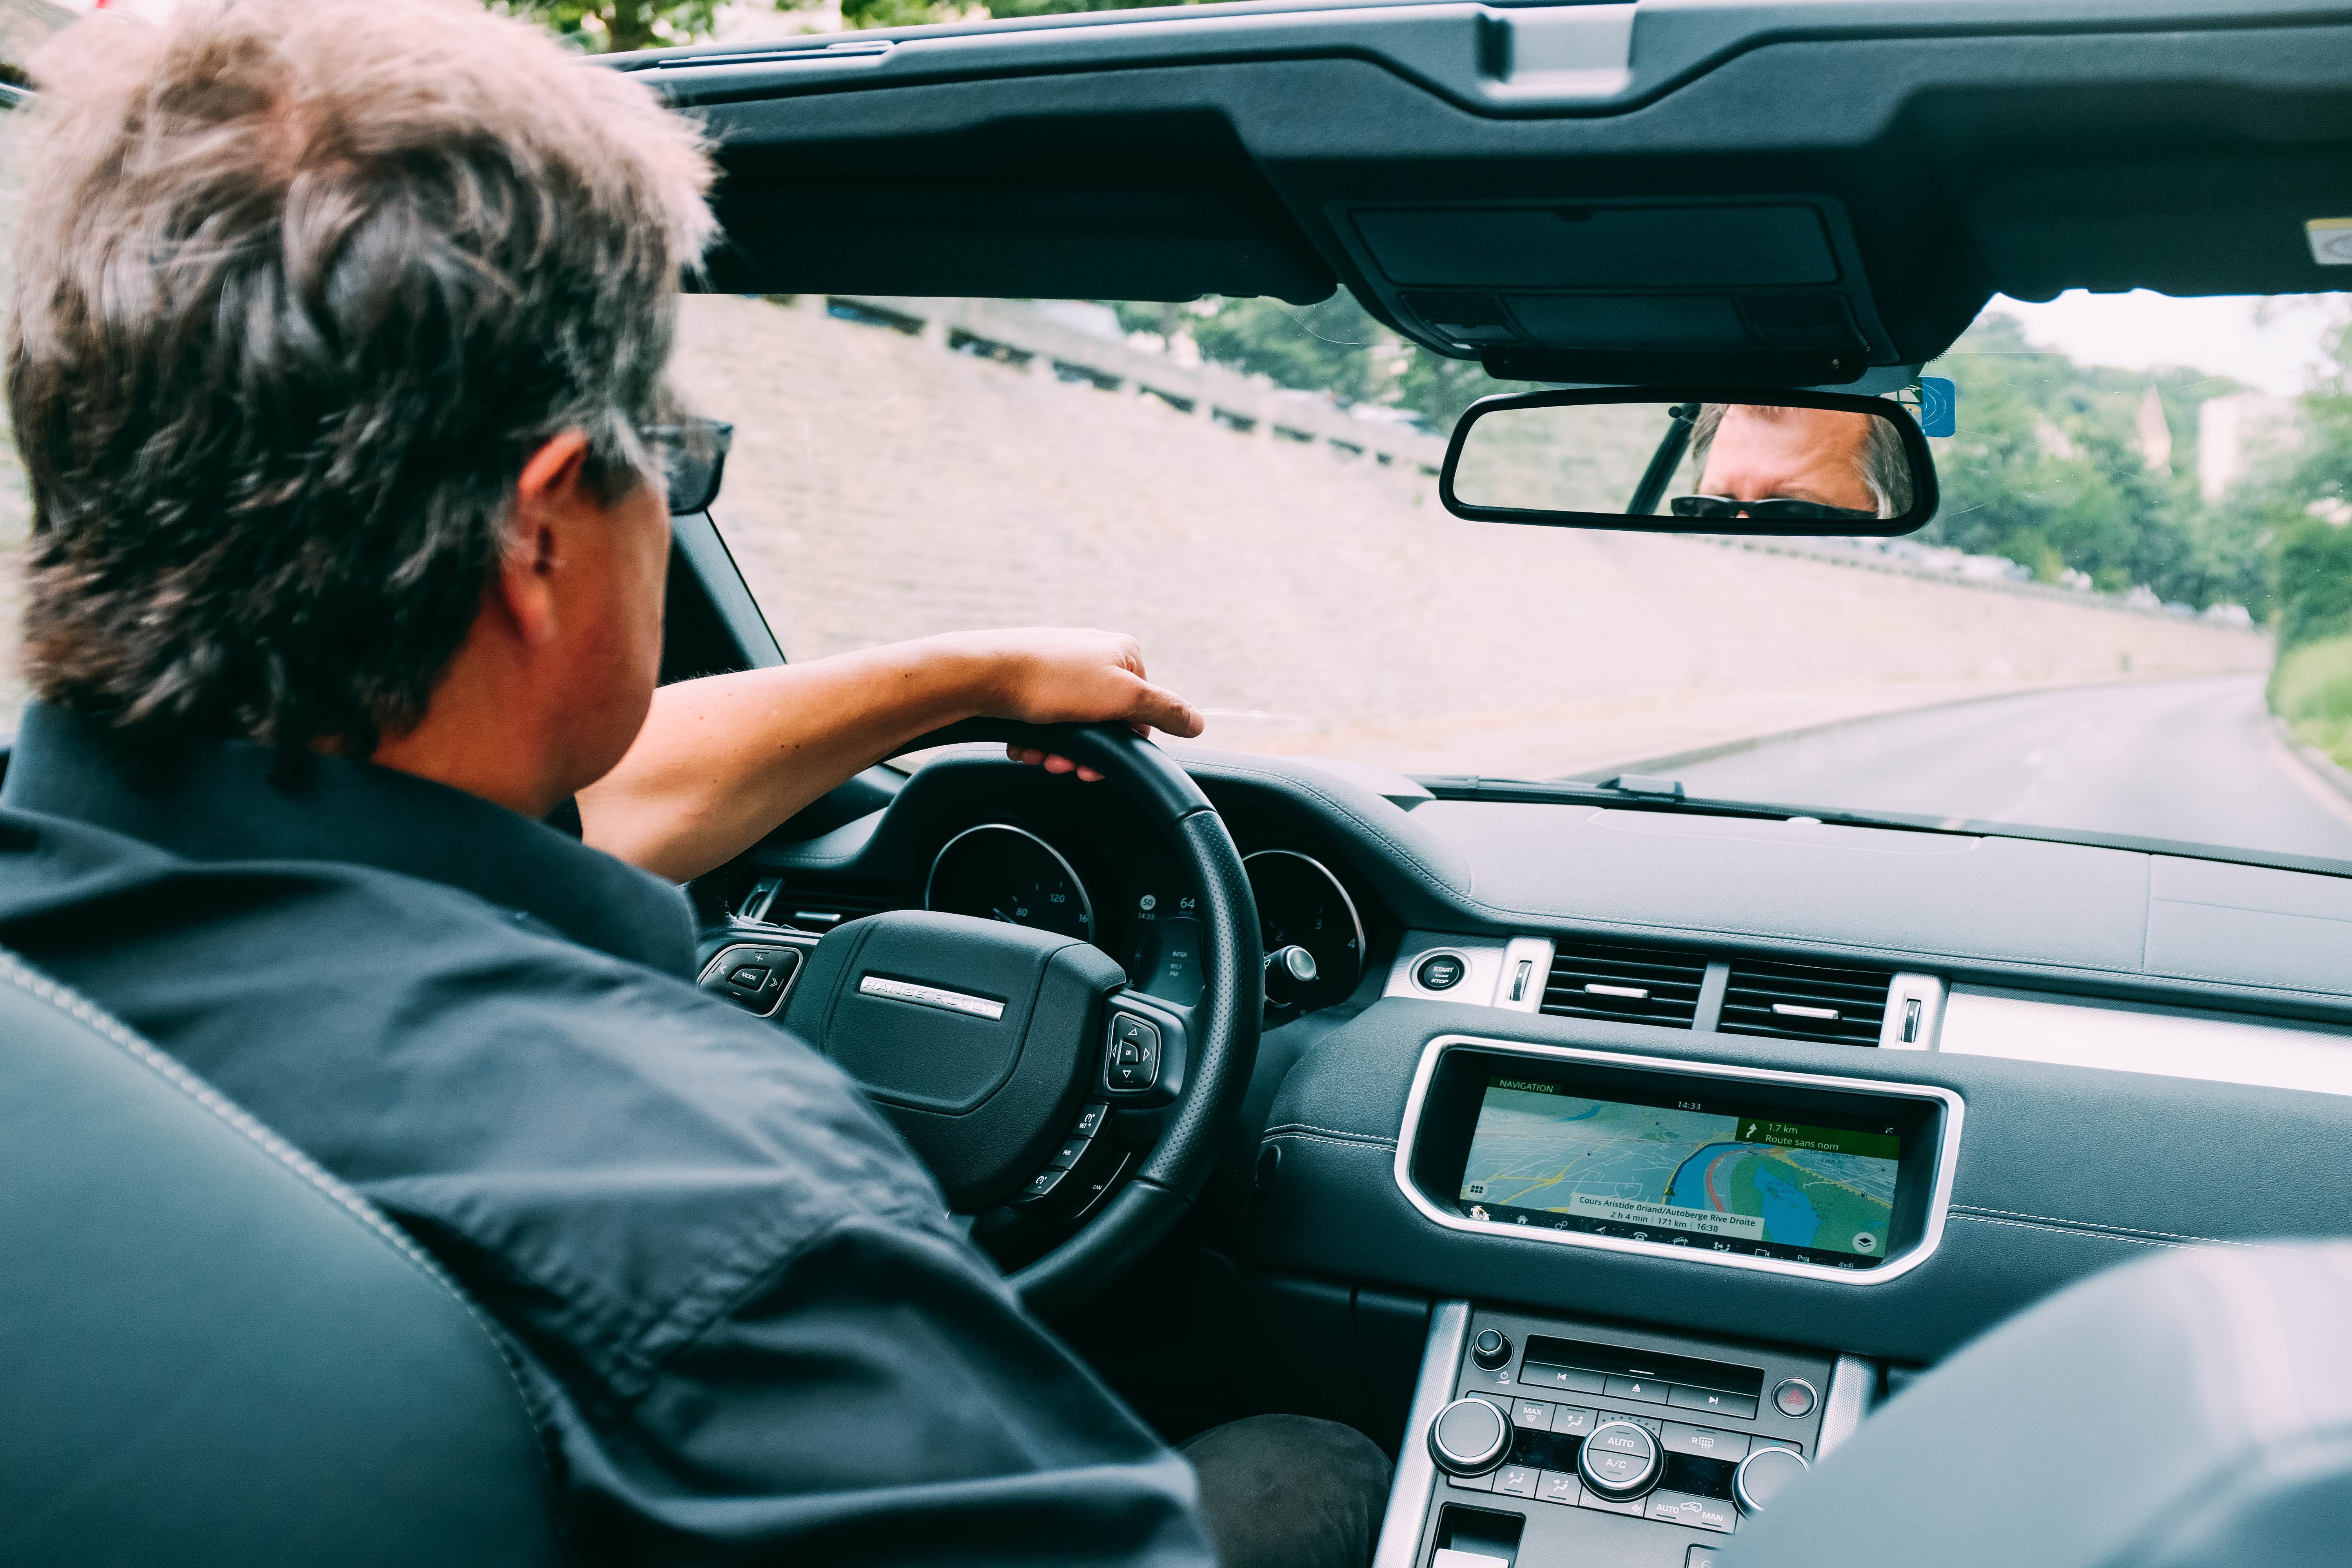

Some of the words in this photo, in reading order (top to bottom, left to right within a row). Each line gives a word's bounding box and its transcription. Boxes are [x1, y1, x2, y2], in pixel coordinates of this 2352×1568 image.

[1051, 894, 1065, 902] 120
[1180, 897, 1195, 909] 64
[1016, 908, 1027, 916] 80
[1315, 919, 1323, 929] 3
[1276, 931, 1284, 941] 2
[1348, 938, 1356, 949] 4
[741, 972, 757, 981] MODE
[864, 981, 927, 999] RANGE
[933, 992, 998, 1014] ROVER
[1500, 1080, 1553, 1093] NAVIGATION
[1678, 1101, 1701, 1110] 14:33
[1769, 1124, 1782, 1132] 1.7
[1784, 1125, 1798, 1134] km
[1766, 1135, 1792, 1145] Route
[1580, 1196, 1602, 1205] Cours
[1604, 1200, 1634, 1210] Aristide
[1637, 1204, 1708, 1221] Briand/Autoberge
[1730, 1217, 1755, 1227] Droite
[1697, 1223, 1718, 1232] 16:38
[1523, 1407, 1543, 1416] MAX
[1607, 1437, 1635, 1448] AUTO
[1606, 1458, 1627, 1468] A/C
[1656, 1503, 1679, 1514] AUTO
[1702, 1511, 1724, 1521] MAN
